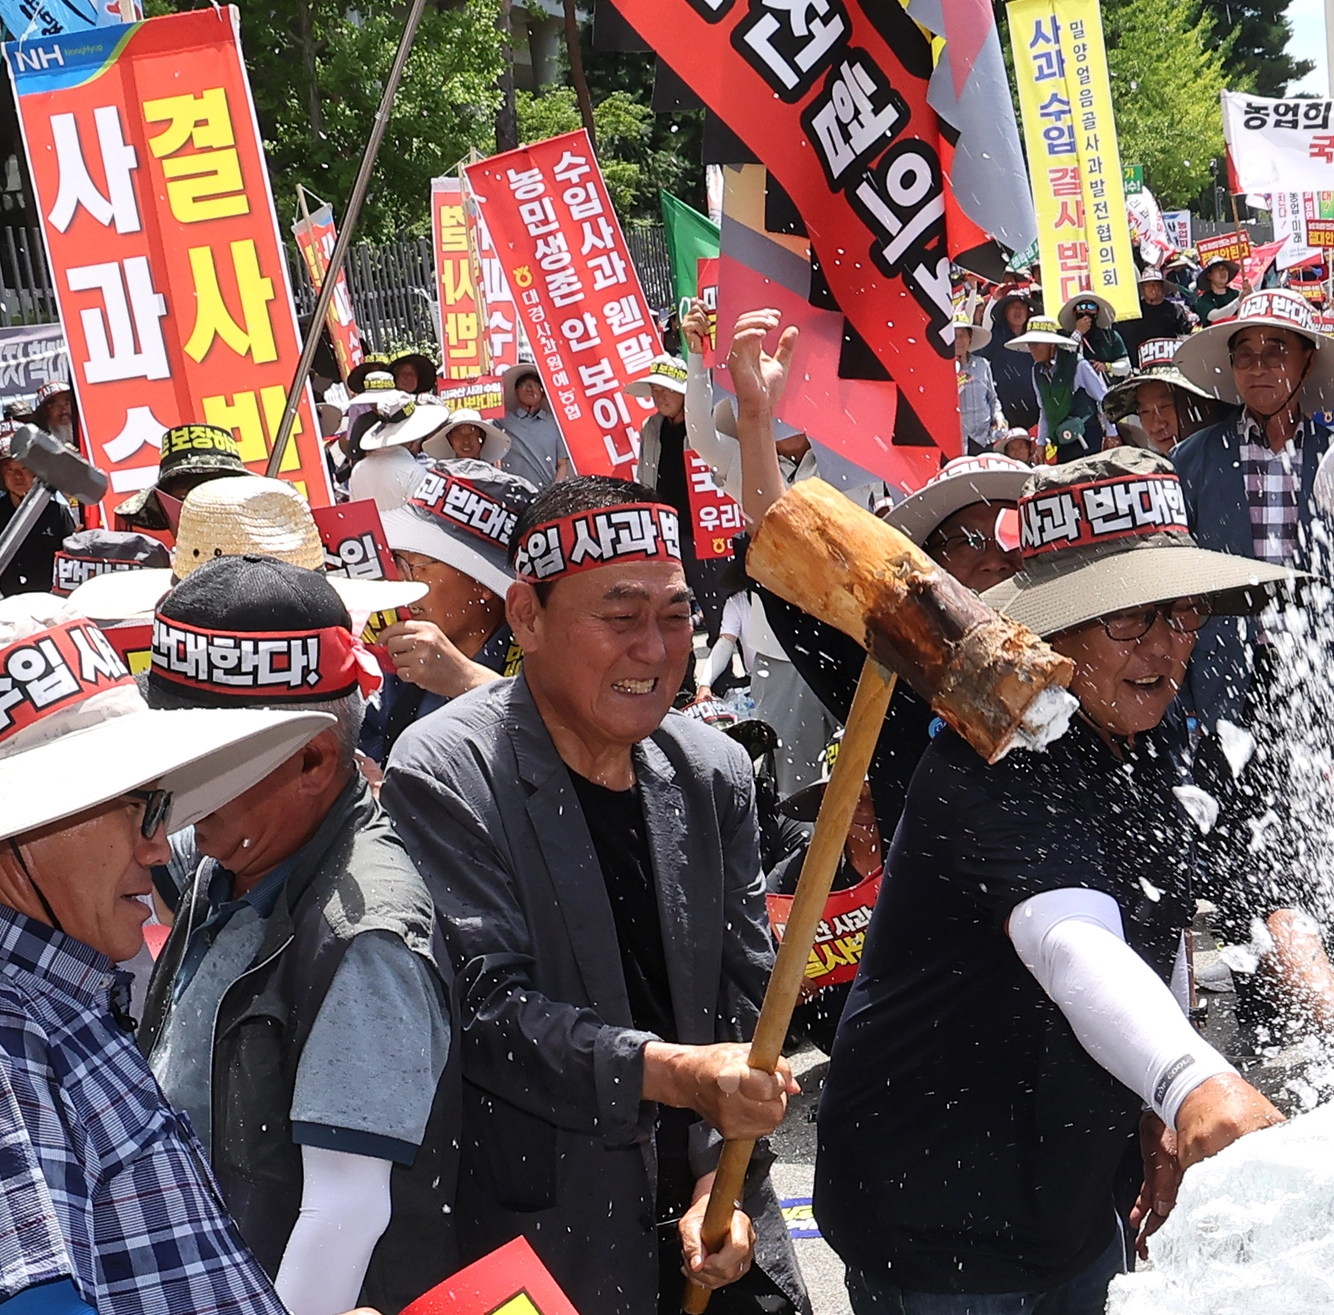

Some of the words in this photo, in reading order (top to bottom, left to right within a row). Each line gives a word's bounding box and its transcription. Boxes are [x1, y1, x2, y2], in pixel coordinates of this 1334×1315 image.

[13, 43, 65, 73] NH
[1029, 14, 1065, 83] 사과
[1039, 91, 1077, 156] 수입
[1048, 166, 1086, 230] 결사
[560, 311, 602, 354] 안
[570, 508, 660, 564] 사과
[1018, 495, 1080, 550] 사과
